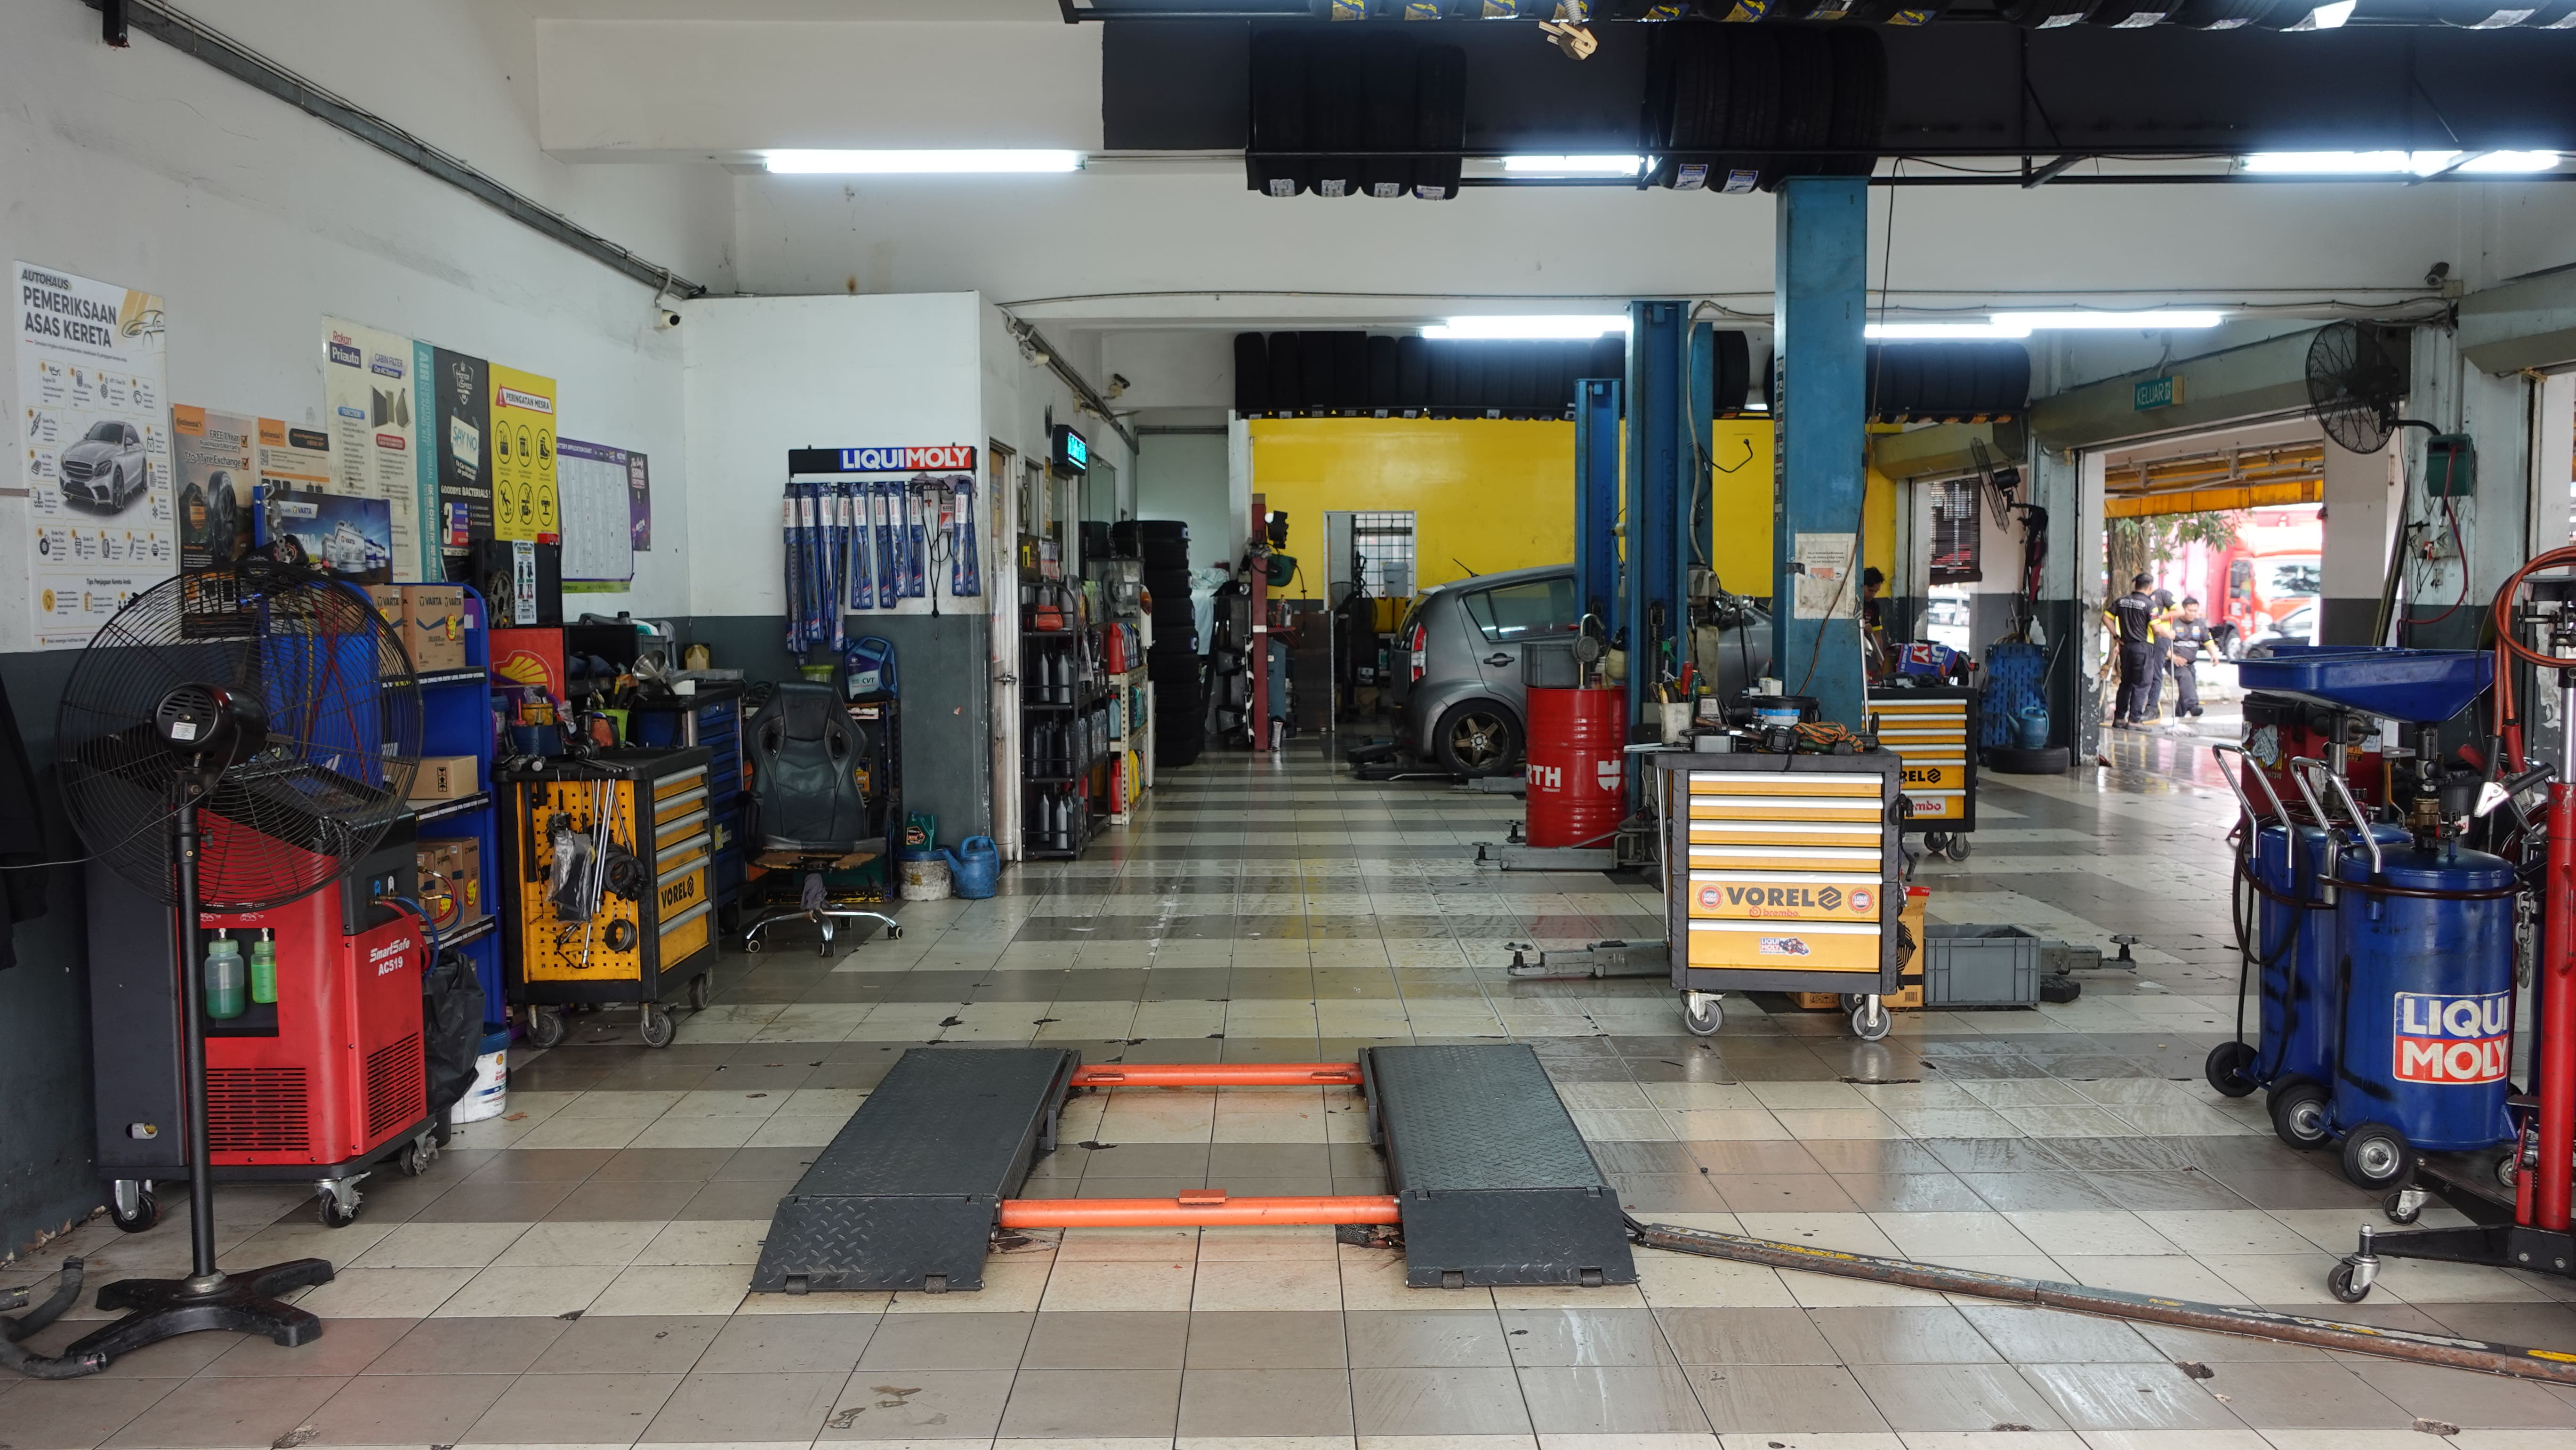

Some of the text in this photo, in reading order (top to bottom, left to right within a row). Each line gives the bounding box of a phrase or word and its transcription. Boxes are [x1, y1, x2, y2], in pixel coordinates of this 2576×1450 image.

[22, 269, 69, 290] AUTOHAUS
[23, 285, 117, 325] PEMERIKSAAN
[24, 312, 112, 348] ASAS KERETA
[333, 330, 351, 345] Rakan
[332, 346, 359, 365] Priauto
[375, 353, 403, 367] CABIN FILTER
[419, 351, 429, 381] AIR
[506, 392, 549, 410] PERINGATAN MESRA
[2137, 384, 2164, 406] KELUAR
[177, 418, 199, 427] Continental
[210, 430, 224, 439] FREE
[227, 433, 240, 442] Year
[260, 429, 280, 438] Continental
[453, 426, 477, 452] SAY NO
[201, 453, 214, 465] Tyre
[214, 456, 241, 467] Exchange
[843, 448, 970, 469] LIQUI MOLY
[441, 485, 461, 495] GOODBYE
[462, 486, 488, 498] BACTERIALS
[298, 507, 312, 515] VARTA
[443, 502, 452, 545] 3
[383, 597, 399, 606] VARTA
[425, 596, 442, 605] VARTA
[449, 596, 461, 606] VARTA
[1526, 763, 1562, 788] RTH
[1900, 771, 1925, 781] REL
[1915, 801, 1941, 811] mbo
[661, 880, 687, 909] VOREL
[1726, 887, 1815, 907] VOREL
[370, 938, 411, 963] SmartSafe
[378, 956, 403, 976] AC519
[2403, 996, 2508, 1038] LIQUI
[2402, 1038, 2507, 1079] MOLY
